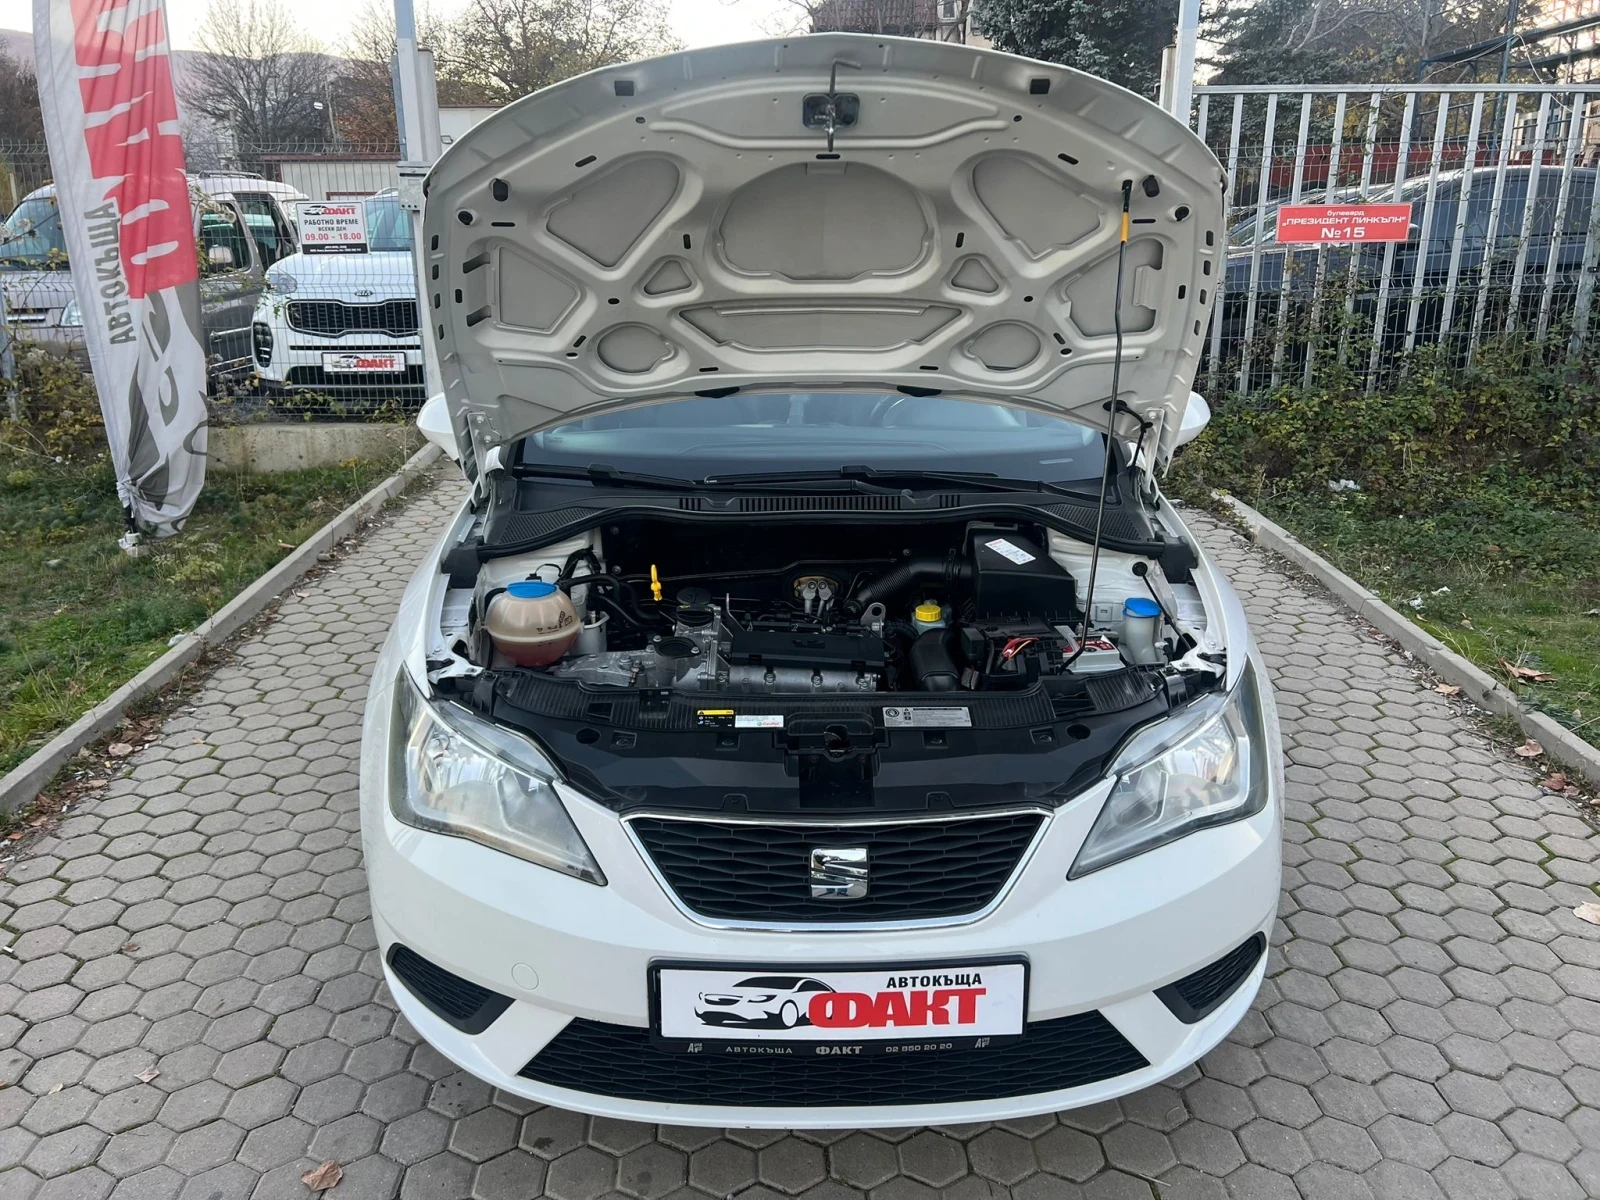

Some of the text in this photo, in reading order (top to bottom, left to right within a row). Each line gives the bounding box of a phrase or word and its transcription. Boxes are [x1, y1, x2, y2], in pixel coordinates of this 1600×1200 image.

[323, 207, 356, 215] ФАКТ
[305, 233, 329, 241] 09.00
[338, 232, 362, 240] 18.00
[84, 202, 137, 345] АВТОКЪЩА
[886, 973, 982, 989] АВТОКЪЩА
[808, 988, 987, 1029] ФАКТ
[815, 1046, 863, 1055] ФАКТ
[939, 1042, 953, 1050] 20
